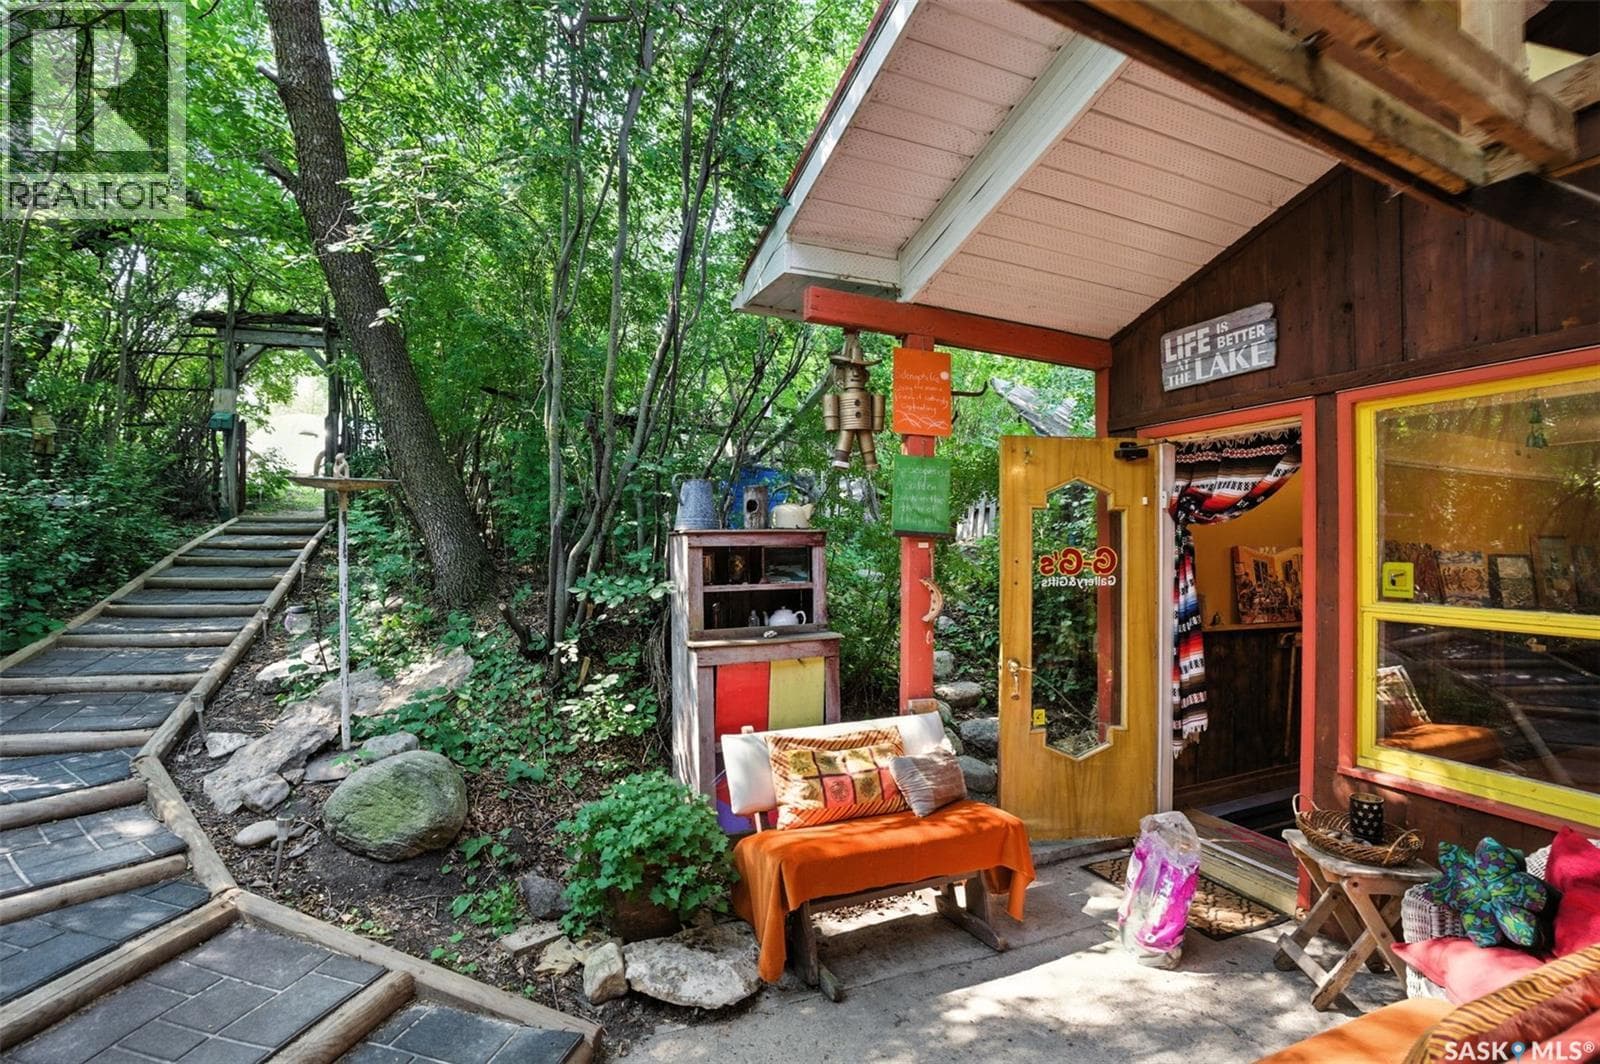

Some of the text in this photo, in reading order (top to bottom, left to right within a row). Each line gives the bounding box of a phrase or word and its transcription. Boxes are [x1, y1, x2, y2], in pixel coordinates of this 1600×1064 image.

[1164, 321, 1229, 363] LIFE IS
[1217, 324, 1266, 349] BETTER
[1168, 339, 1269, 387] THE LAKE
[1175, 358, 1190, 372] AT
